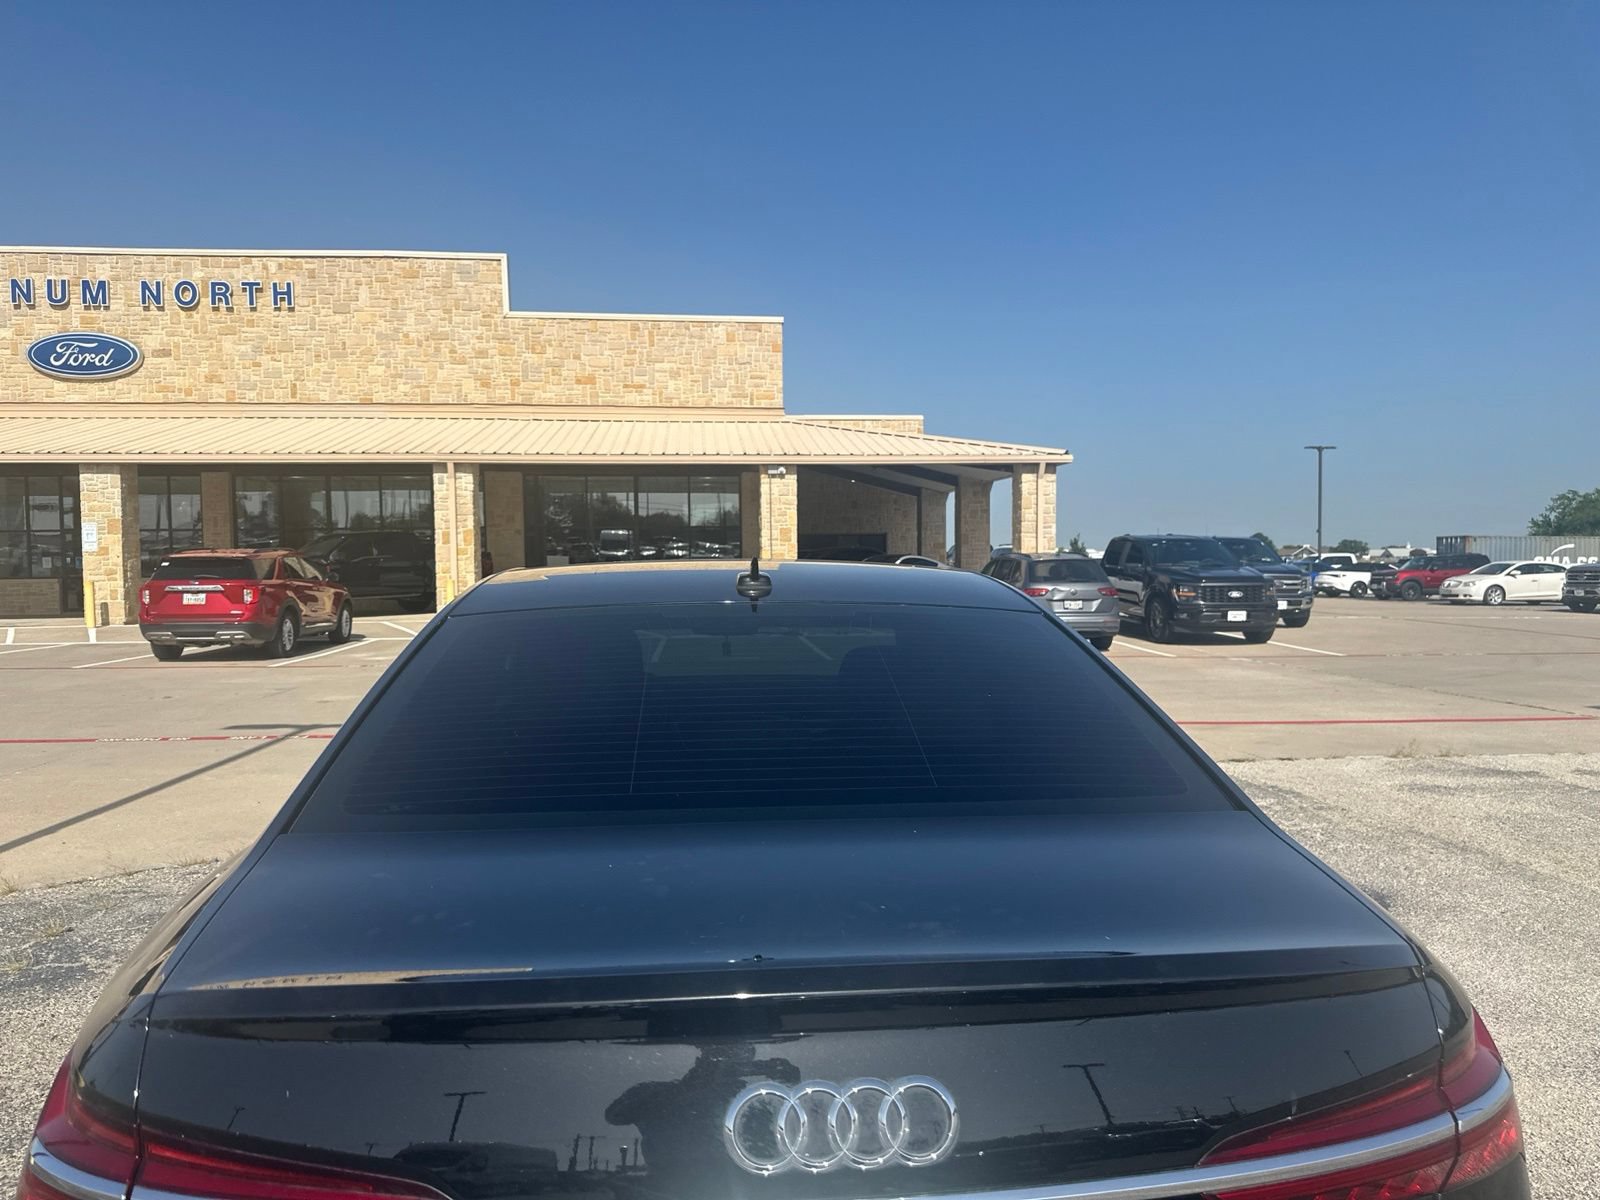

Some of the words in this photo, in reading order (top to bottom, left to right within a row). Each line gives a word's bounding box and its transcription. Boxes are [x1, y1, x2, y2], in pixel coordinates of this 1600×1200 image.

[9, 277, 109, 306] NUM
[139, 279, 295, 308] NORTH
[49, 341, 114, 367] Ford
